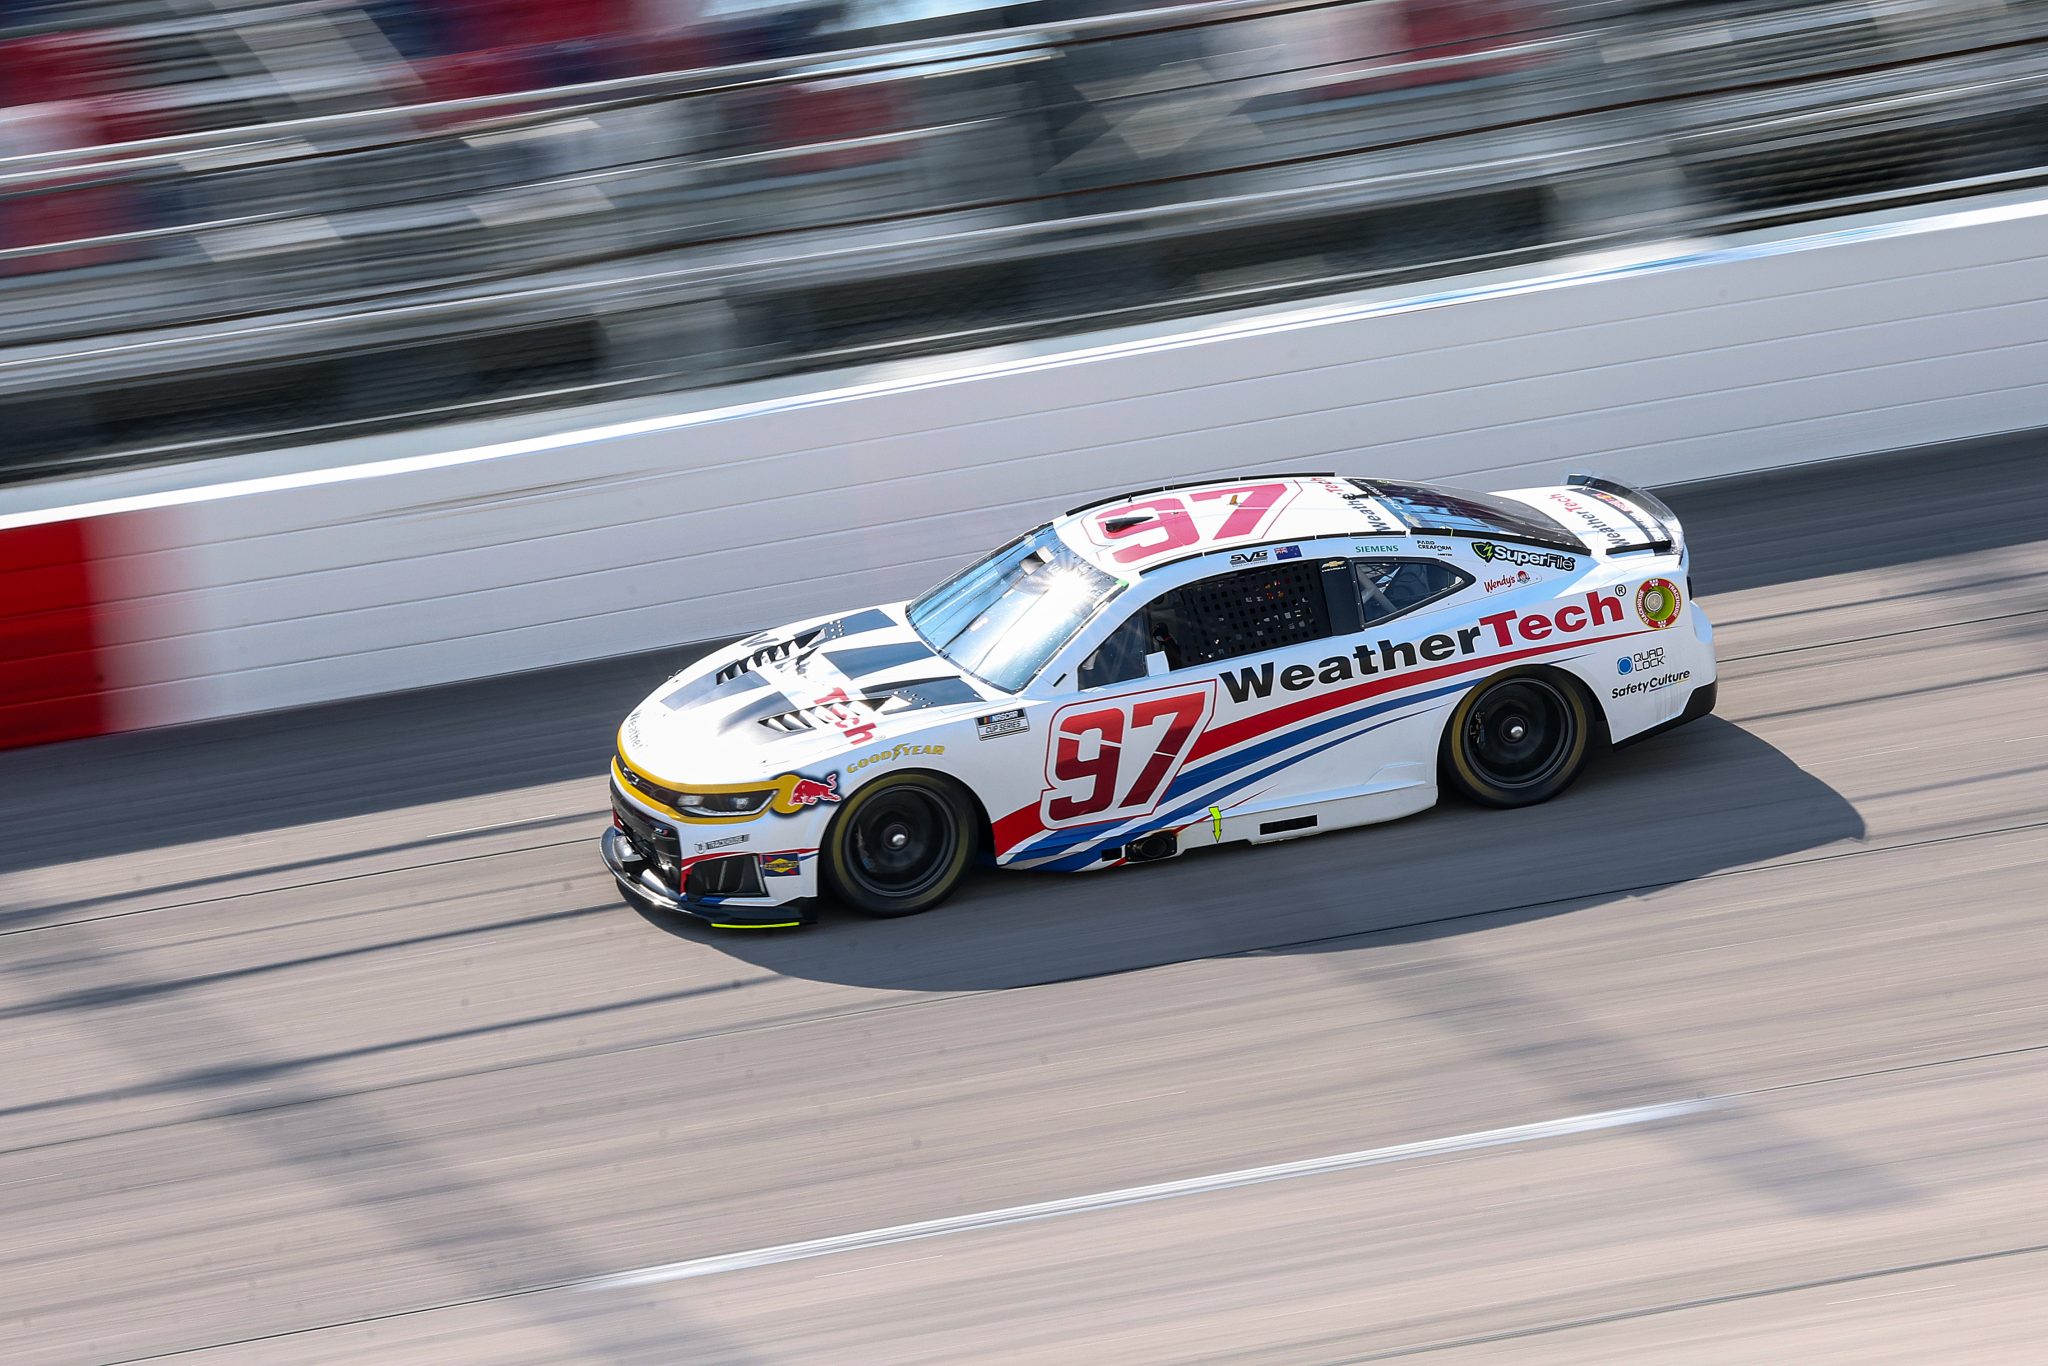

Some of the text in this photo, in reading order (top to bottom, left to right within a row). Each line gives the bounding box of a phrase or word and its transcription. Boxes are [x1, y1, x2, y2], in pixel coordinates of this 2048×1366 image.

[1097, 483, 1287, 563] 97
[1229, 549, 1268, 565] SVG
[1355, 545, 1399, 553] SIEMENS
[1493, 545, 1574, 571] SuperFile
[1483, 574, 1516, 593] Wendy's
[1633, 647, 1664, 663] QUAD
[1634, 656, 1665, 672] LOCK
[1611, 670, 1690, 699] SafetyCulture
[846, 742, 946, 774] GOODYEAR
[1049, 692, 1206, 821] 97
